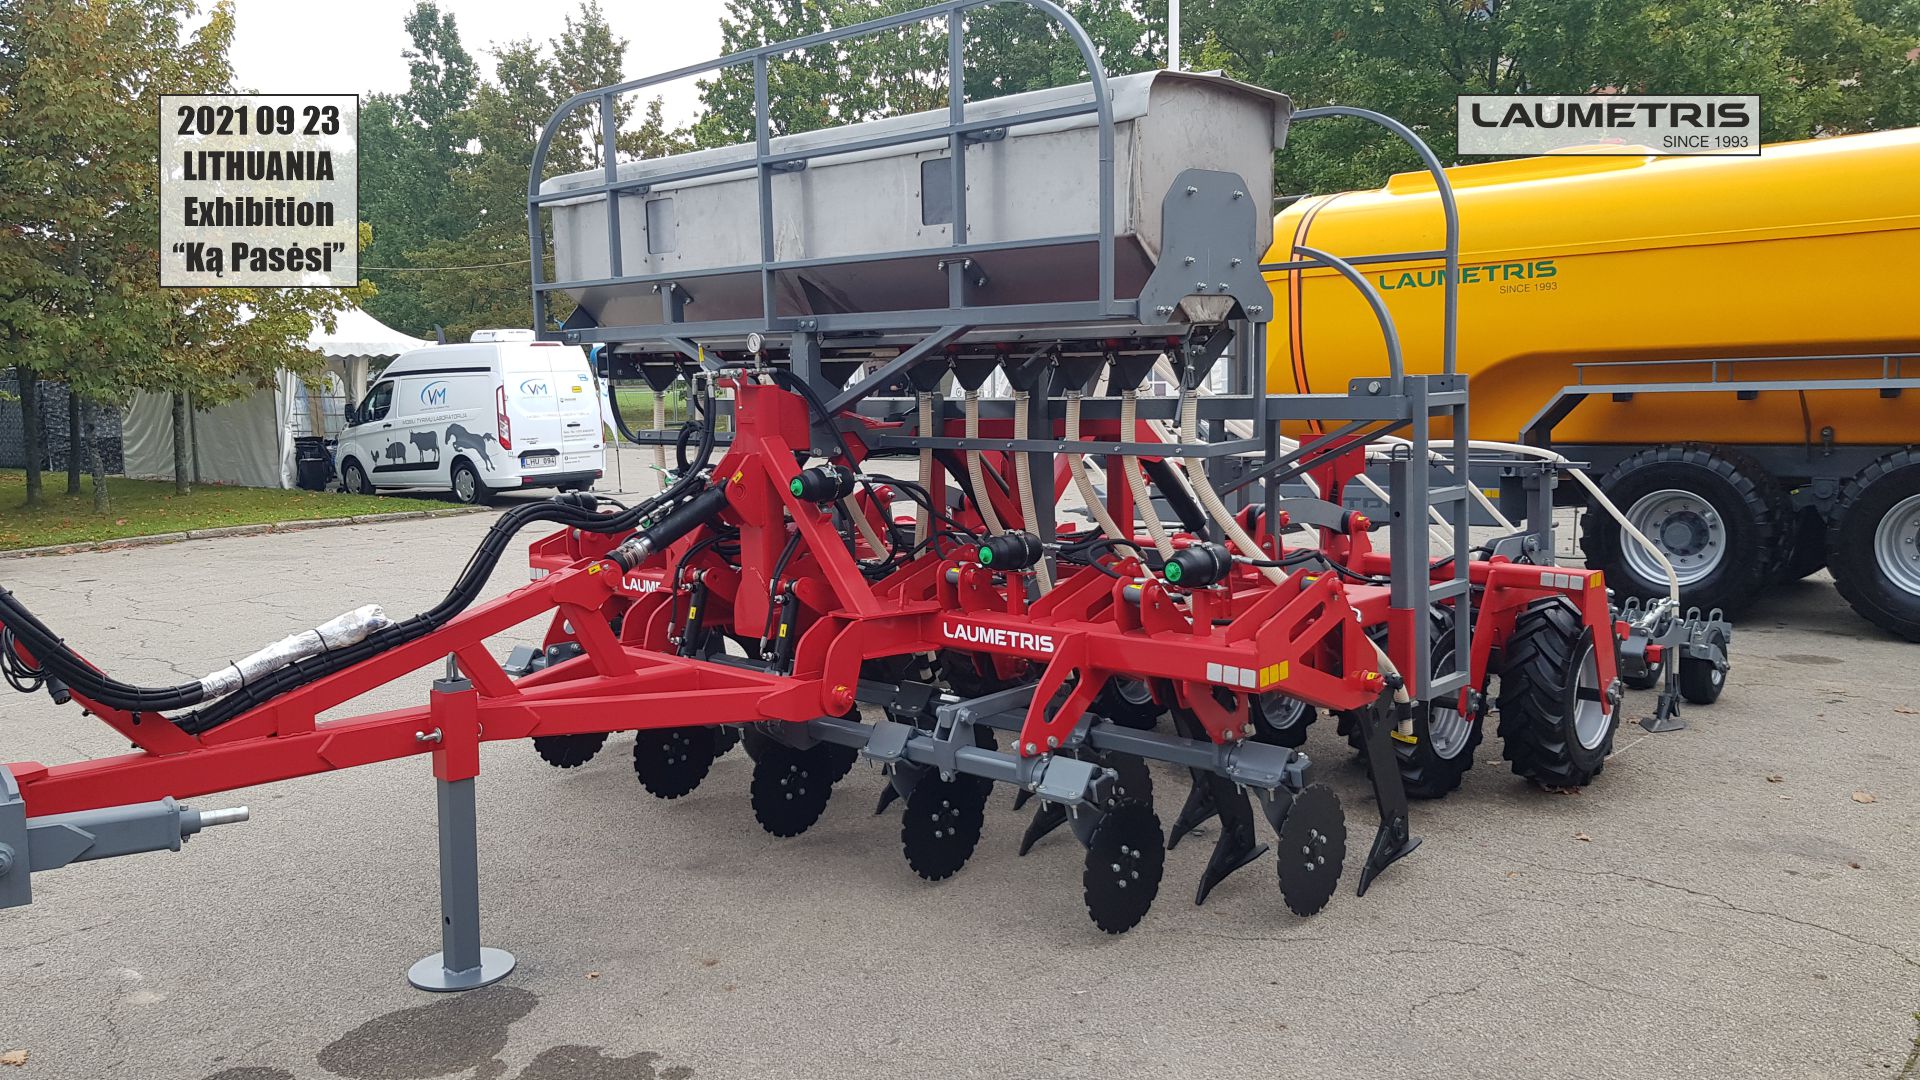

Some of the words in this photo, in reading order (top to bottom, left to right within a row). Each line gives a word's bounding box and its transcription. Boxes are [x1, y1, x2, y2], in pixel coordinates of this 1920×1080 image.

[1499, 284, 1531, 294] SINCE
[1534, 282, 1558, 292] 1993
[943, 621, 1054, 653] LAUMETRIS
